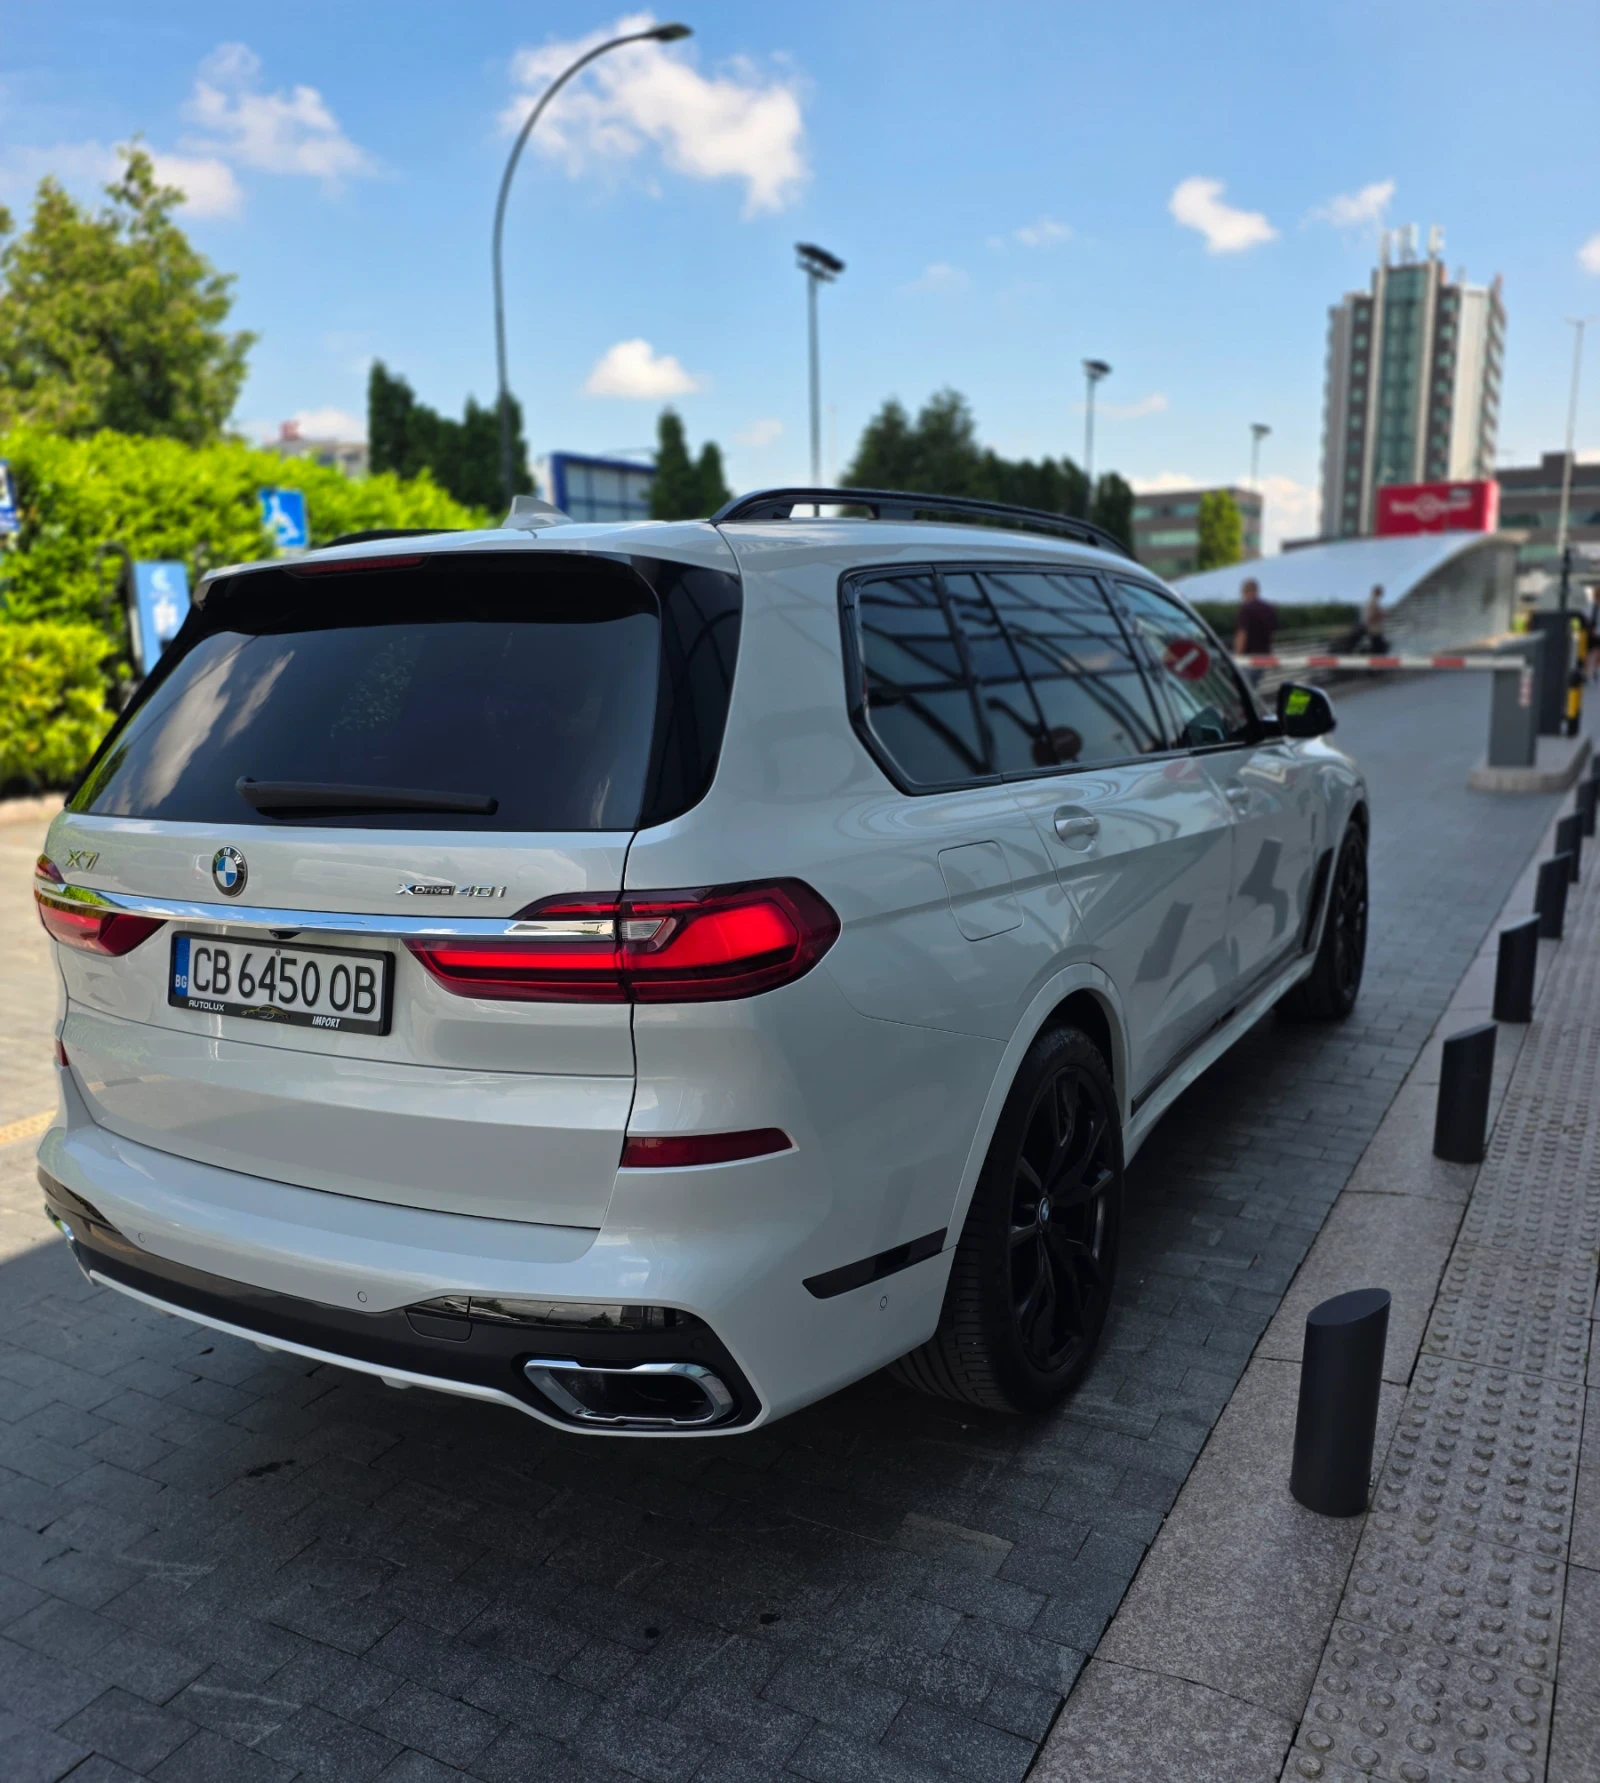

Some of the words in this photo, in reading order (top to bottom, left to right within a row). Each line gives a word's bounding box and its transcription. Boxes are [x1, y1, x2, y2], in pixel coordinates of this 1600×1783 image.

[65, 849, 100, 870] X7
[214, 847, 243, 865] BMW
[175, 973, 188, 989] BG
[193, 947, 231, 995] CB
[238, 953, 321, 1007] 6450
[188, 999, 225, 1012] AUTOLUX
[312, 1015, 341, 1028] IMPORT
